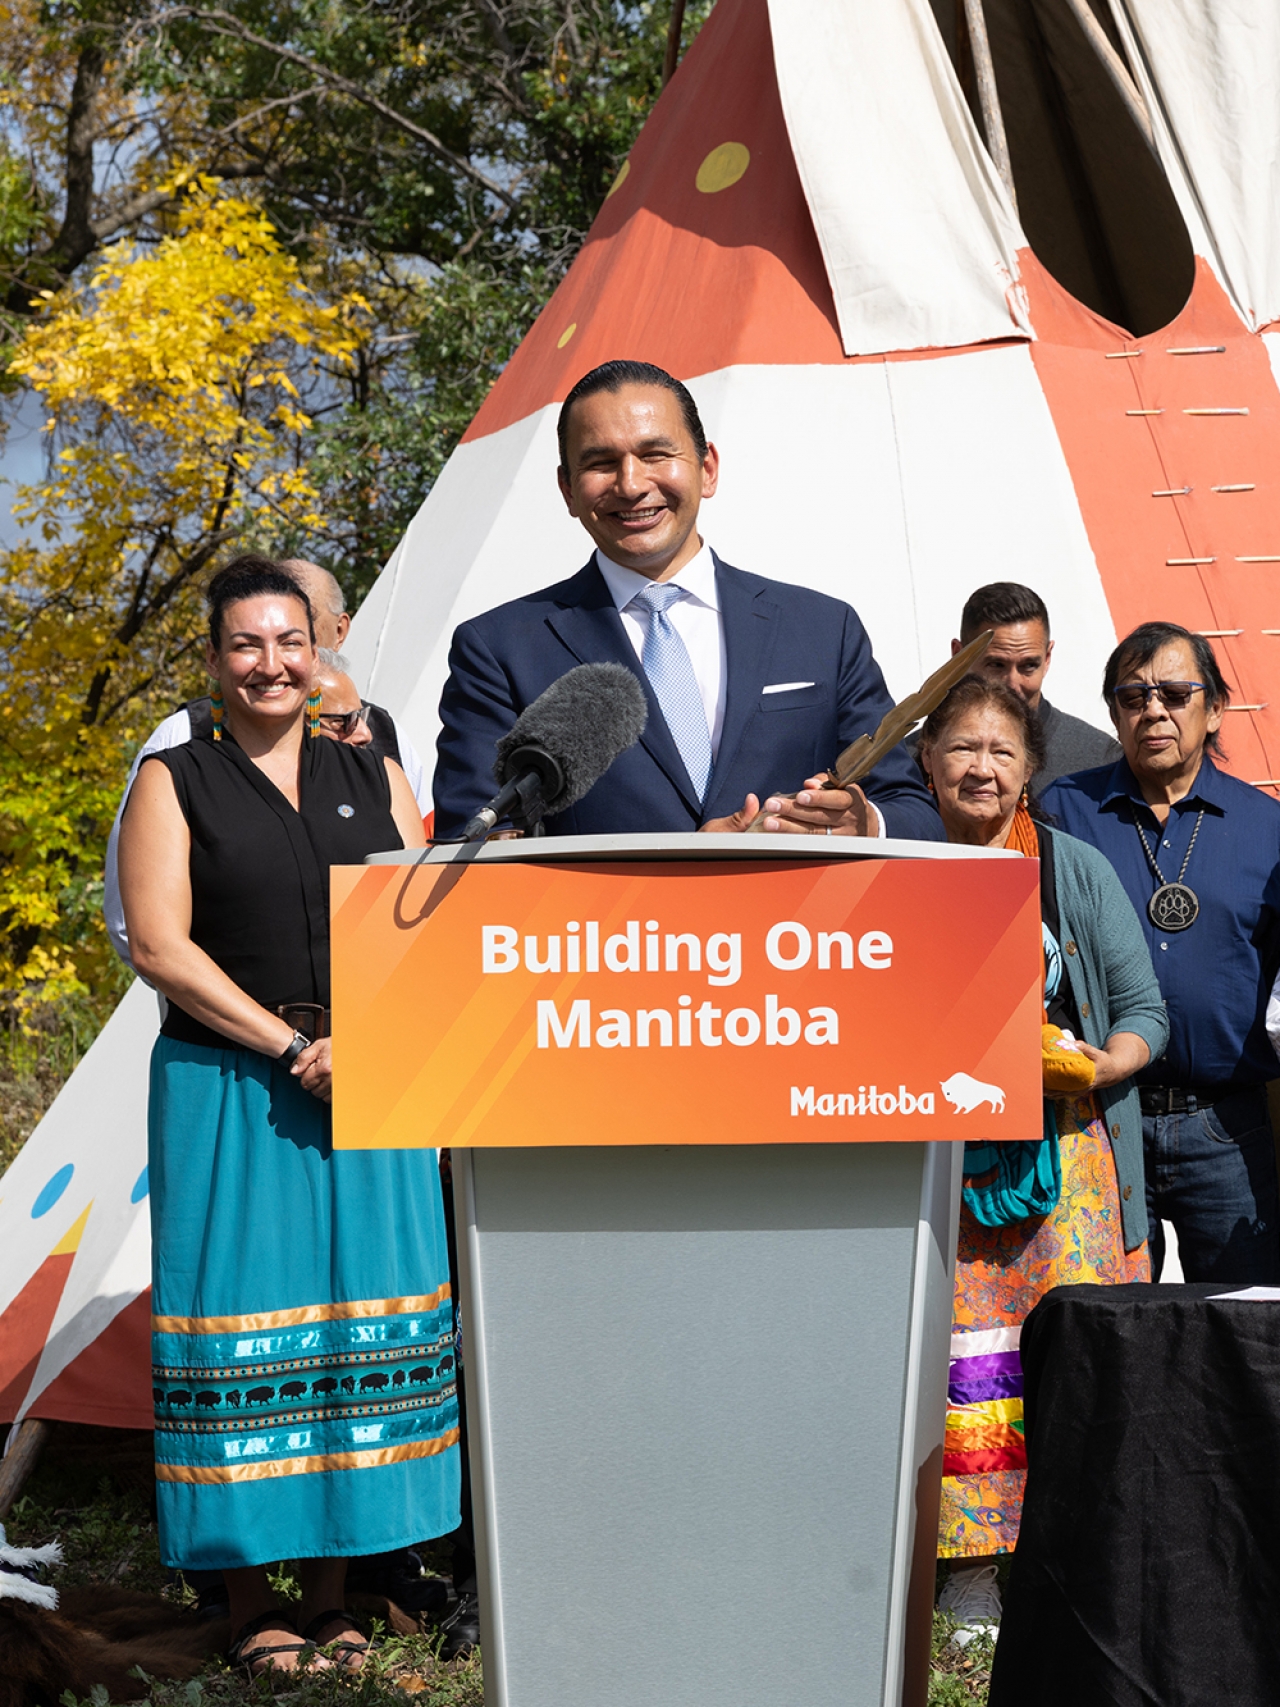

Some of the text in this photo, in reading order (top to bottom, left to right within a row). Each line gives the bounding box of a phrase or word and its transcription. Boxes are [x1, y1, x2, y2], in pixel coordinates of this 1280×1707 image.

[481, 920, 893, 987] Building One
[537, 994, 840, 1048] Manitoba
[790, 1085, 936, 1117] Manitoba
